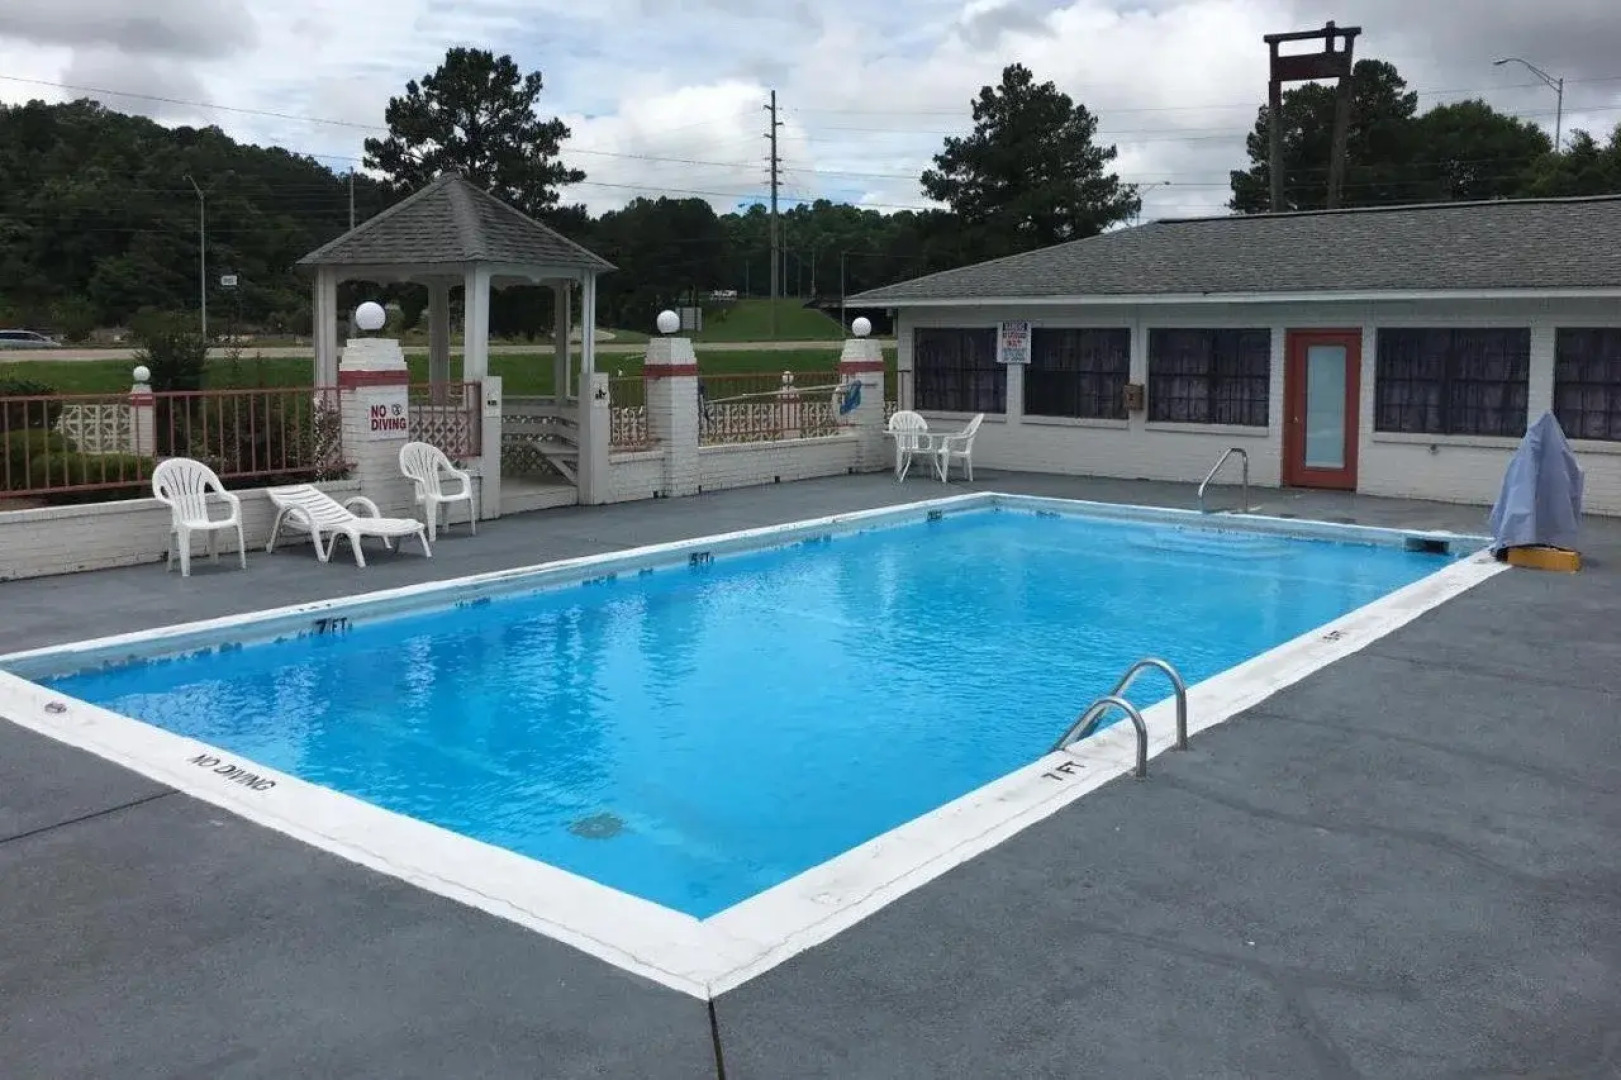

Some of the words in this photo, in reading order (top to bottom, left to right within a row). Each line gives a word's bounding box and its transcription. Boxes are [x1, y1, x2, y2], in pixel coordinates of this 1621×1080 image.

[371, 404, 387, 418] NO
[371, 417, 406, 431] DIVING
[188, 754, 220, 767] NO
[213, 764, 276, 791] DIVING
